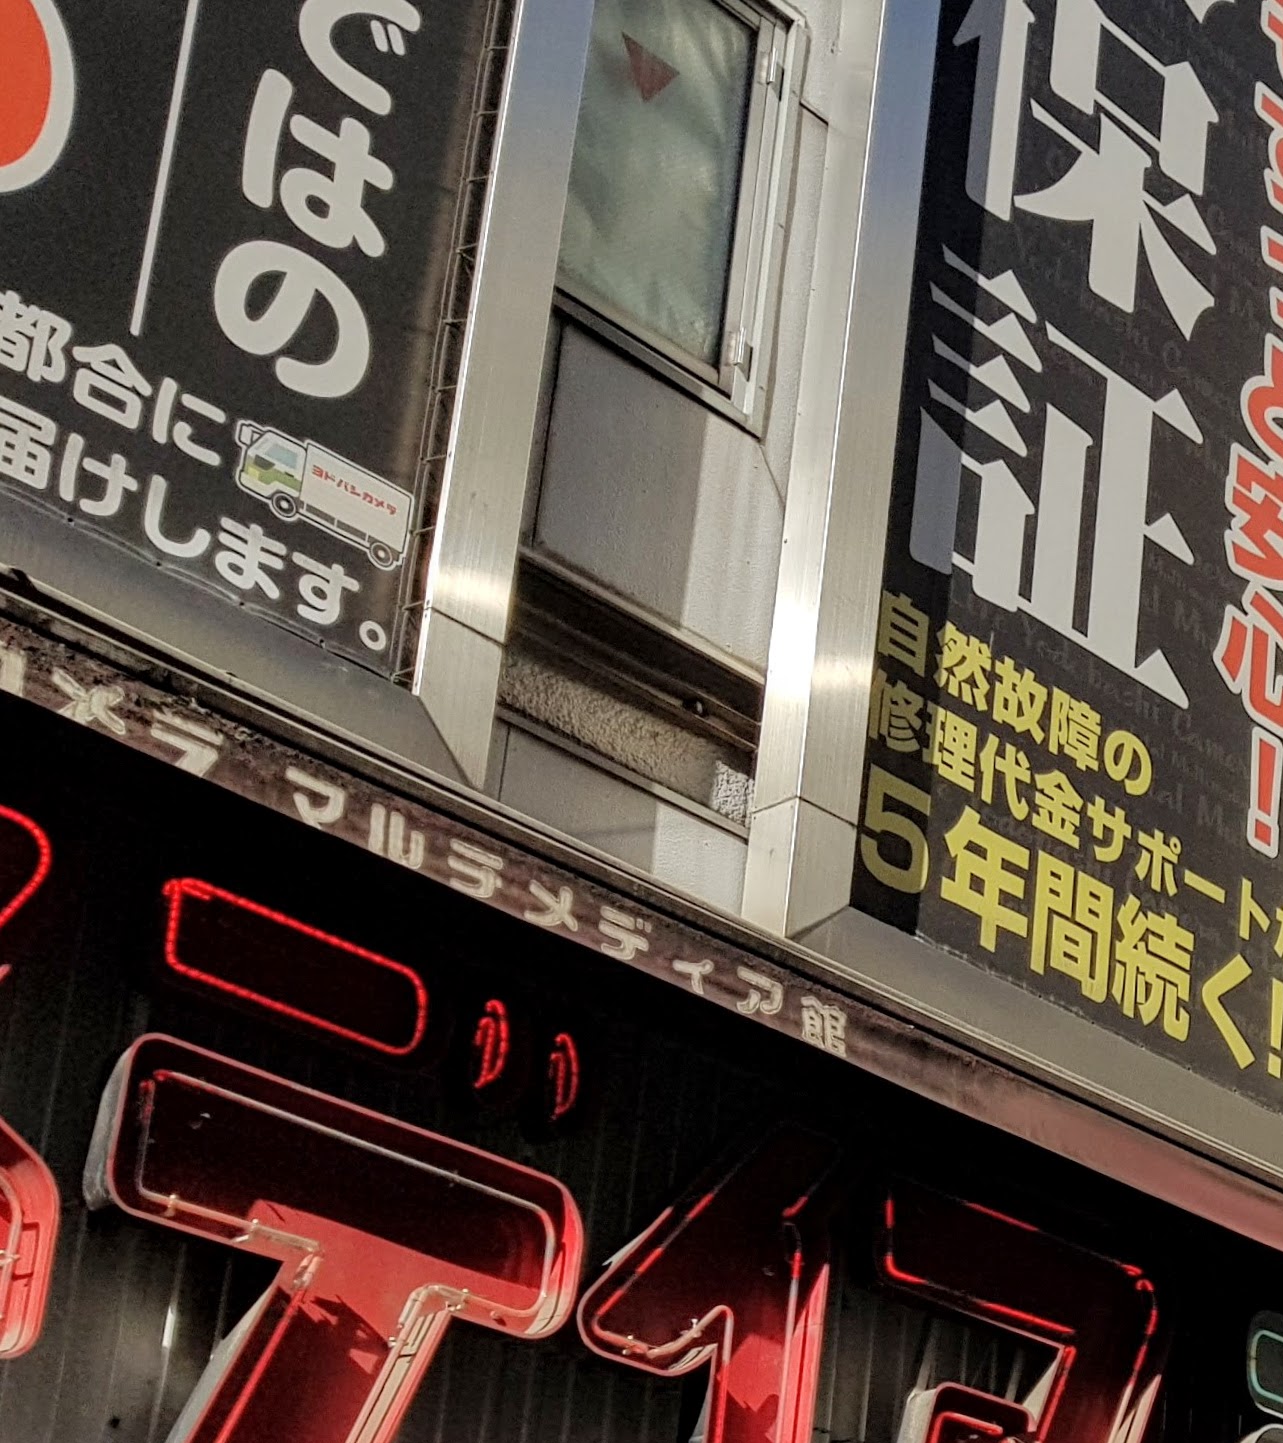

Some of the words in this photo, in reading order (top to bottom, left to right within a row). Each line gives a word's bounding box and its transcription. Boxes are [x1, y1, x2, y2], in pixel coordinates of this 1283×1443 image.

[310, 463, 398, 517] ヨドバシカメラ
[876, 590, 1154, 800] 自然故障の
